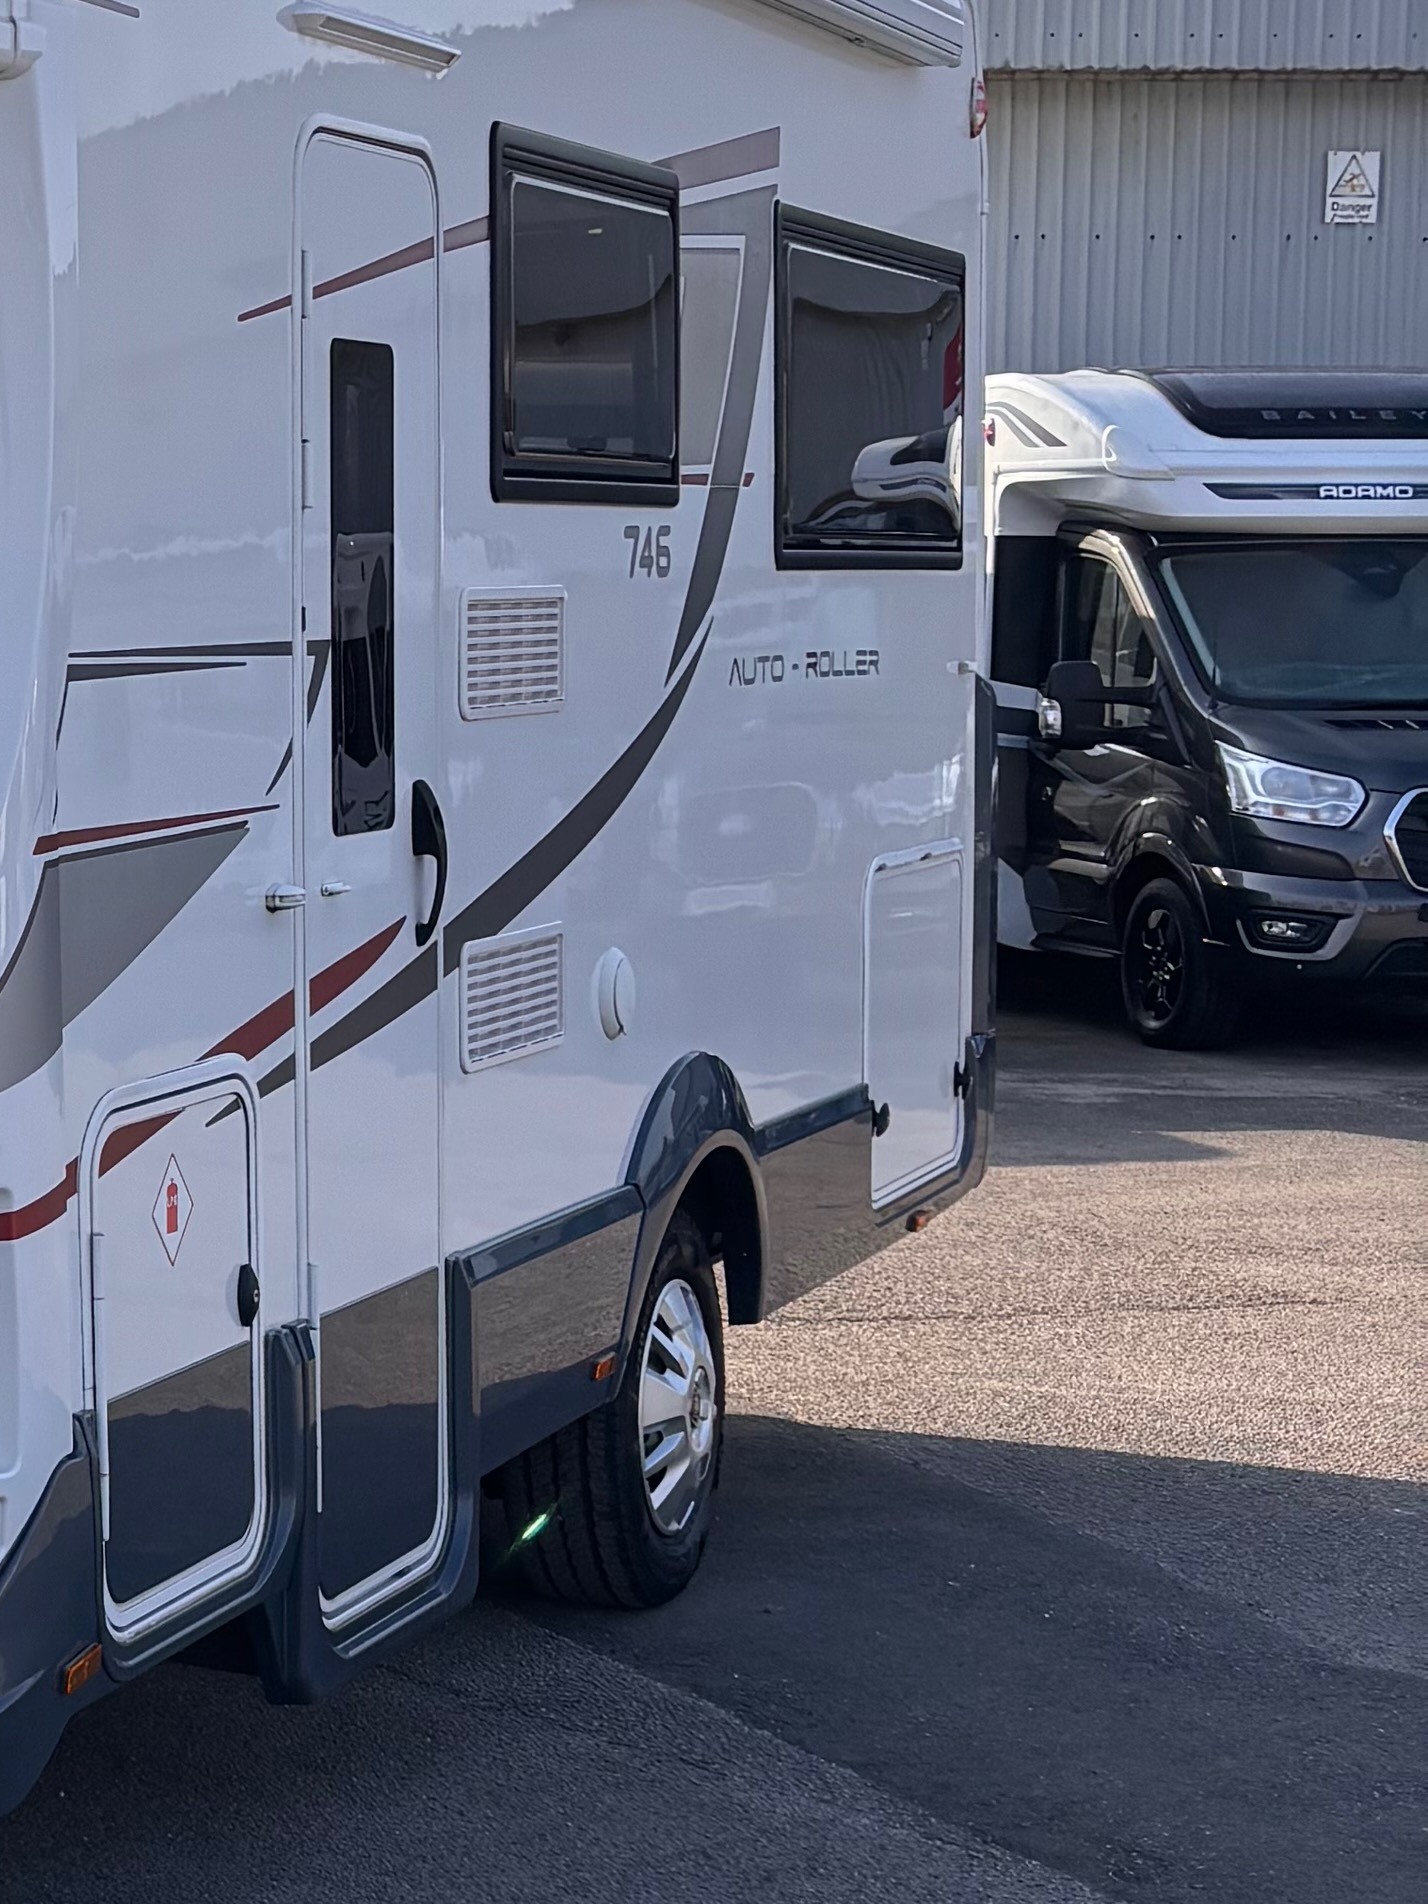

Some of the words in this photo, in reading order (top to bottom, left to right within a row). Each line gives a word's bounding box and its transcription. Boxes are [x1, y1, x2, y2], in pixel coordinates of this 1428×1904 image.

[1331, 202, 1373, 214] Danger
[1260, 410, 1427, 420] BAILEY
[1319, 485, 1414, 498] ADAMO
[623, 525, 672, 579] 746
[729, 654, 784, 687] AUTO
[805, 649, 880, 678] ROLLER
